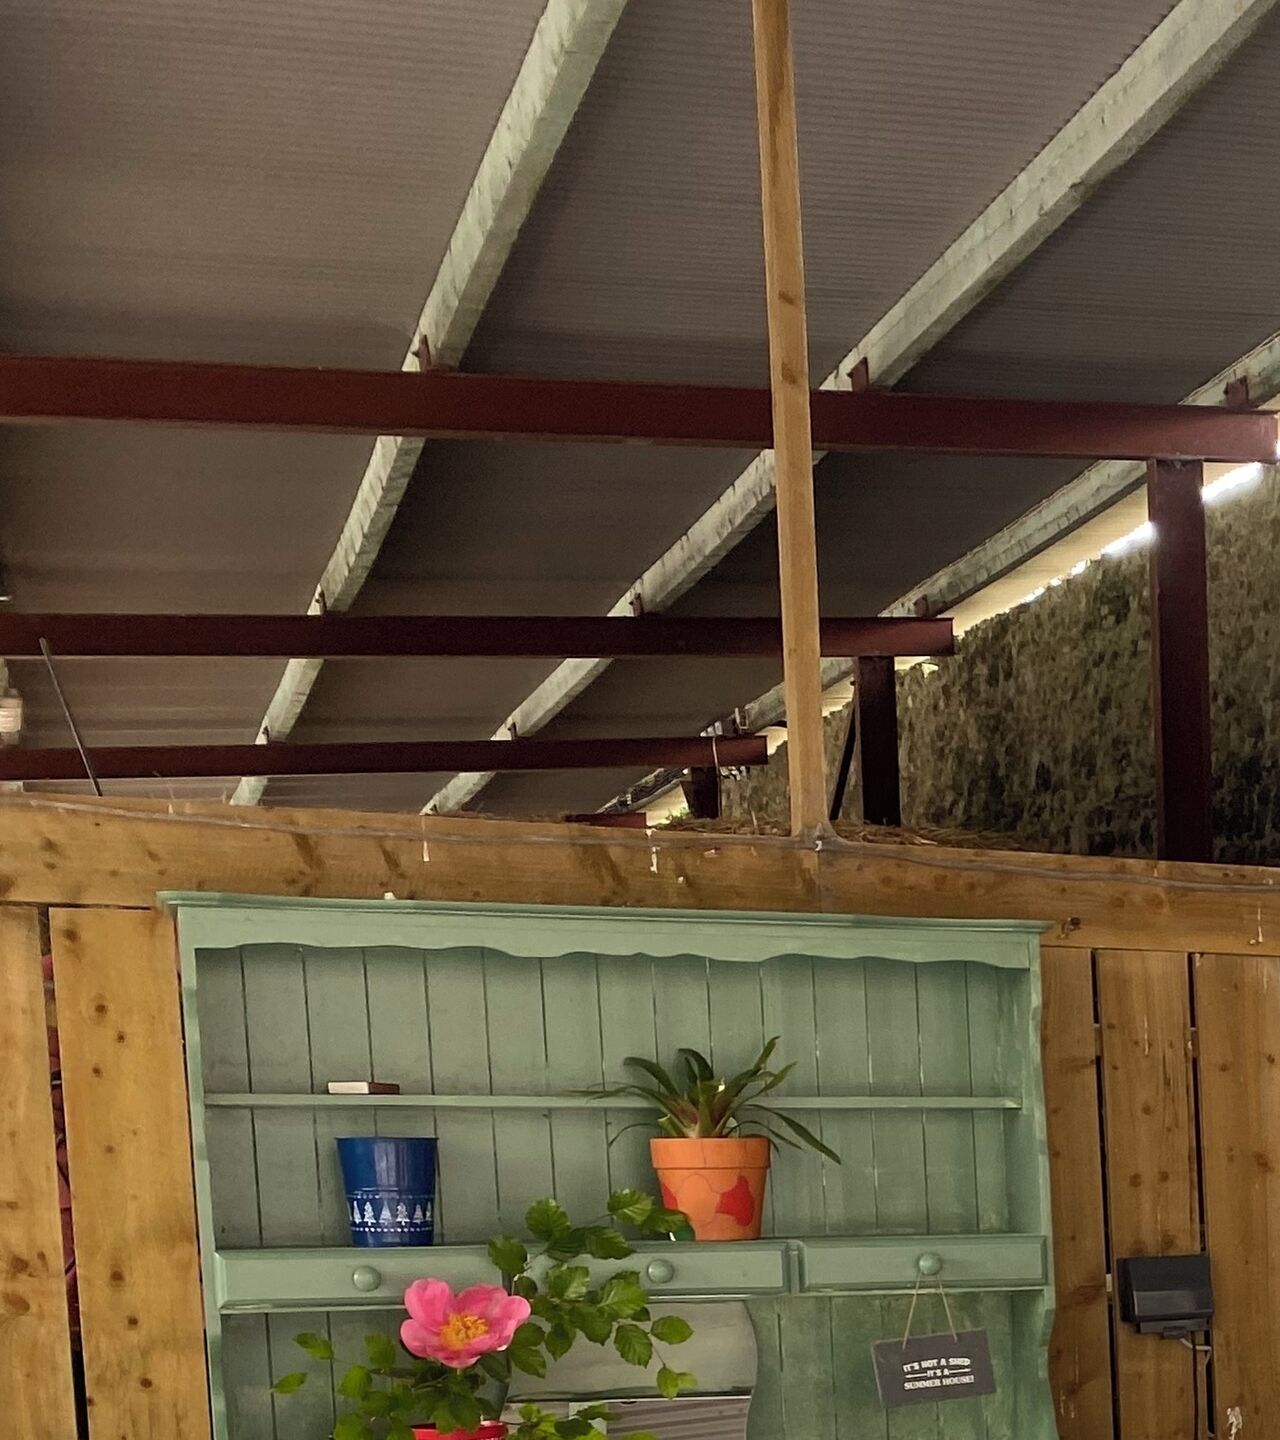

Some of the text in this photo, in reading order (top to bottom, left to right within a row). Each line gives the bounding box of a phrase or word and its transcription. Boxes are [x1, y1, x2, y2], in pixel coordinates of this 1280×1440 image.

[920, 1359, 938, 1368] NOT
[940, 1358, 947, 1366] A
[943, 1368, 949, 1376] A
[942, 1375, 974, 1386] HOUSE
